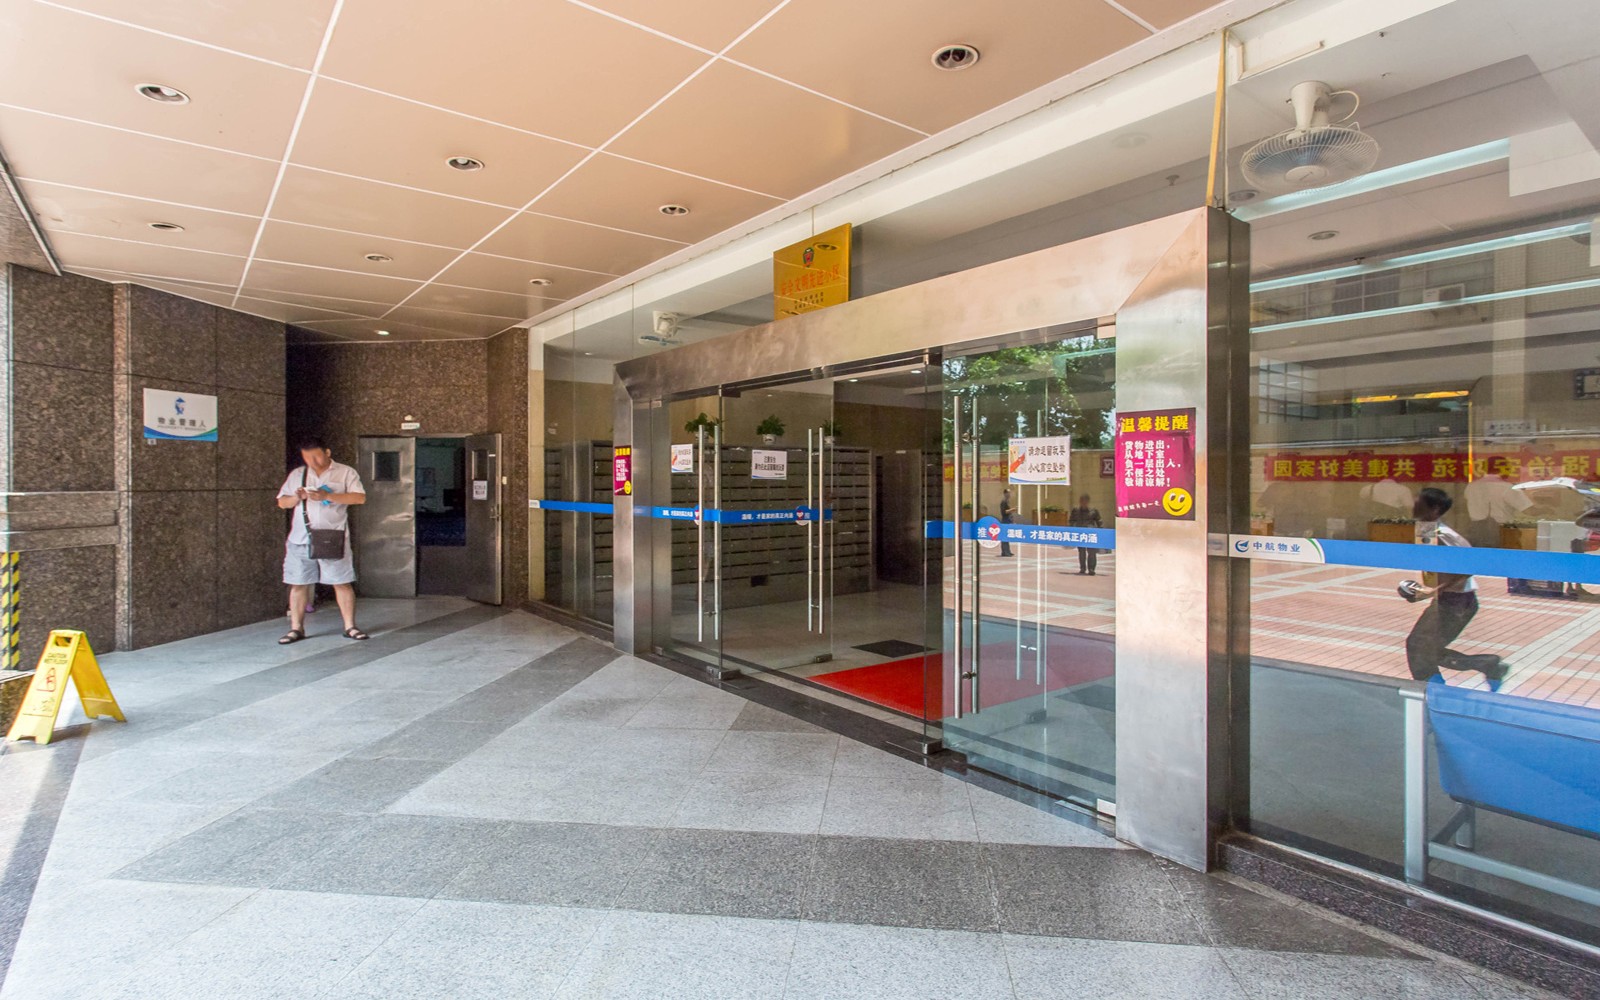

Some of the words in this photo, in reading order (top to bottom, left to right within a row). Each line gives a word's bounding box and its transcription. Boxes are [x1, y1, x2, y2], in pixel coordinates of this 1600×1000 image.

[1121, 415, 1188, 432] 温馨提醒
[1124, 450, 1165, 459] 从地下室
[1028, 462, 1066, 473] 小心高空坠物
[1124, 468, 1165, 478] 不便之处
[977, 527, 988, 538] 推
[1006, 528, 1098, 544] 温暖，才是家的真正内涵
[1253, 541, 1301, 553] 中航物业
